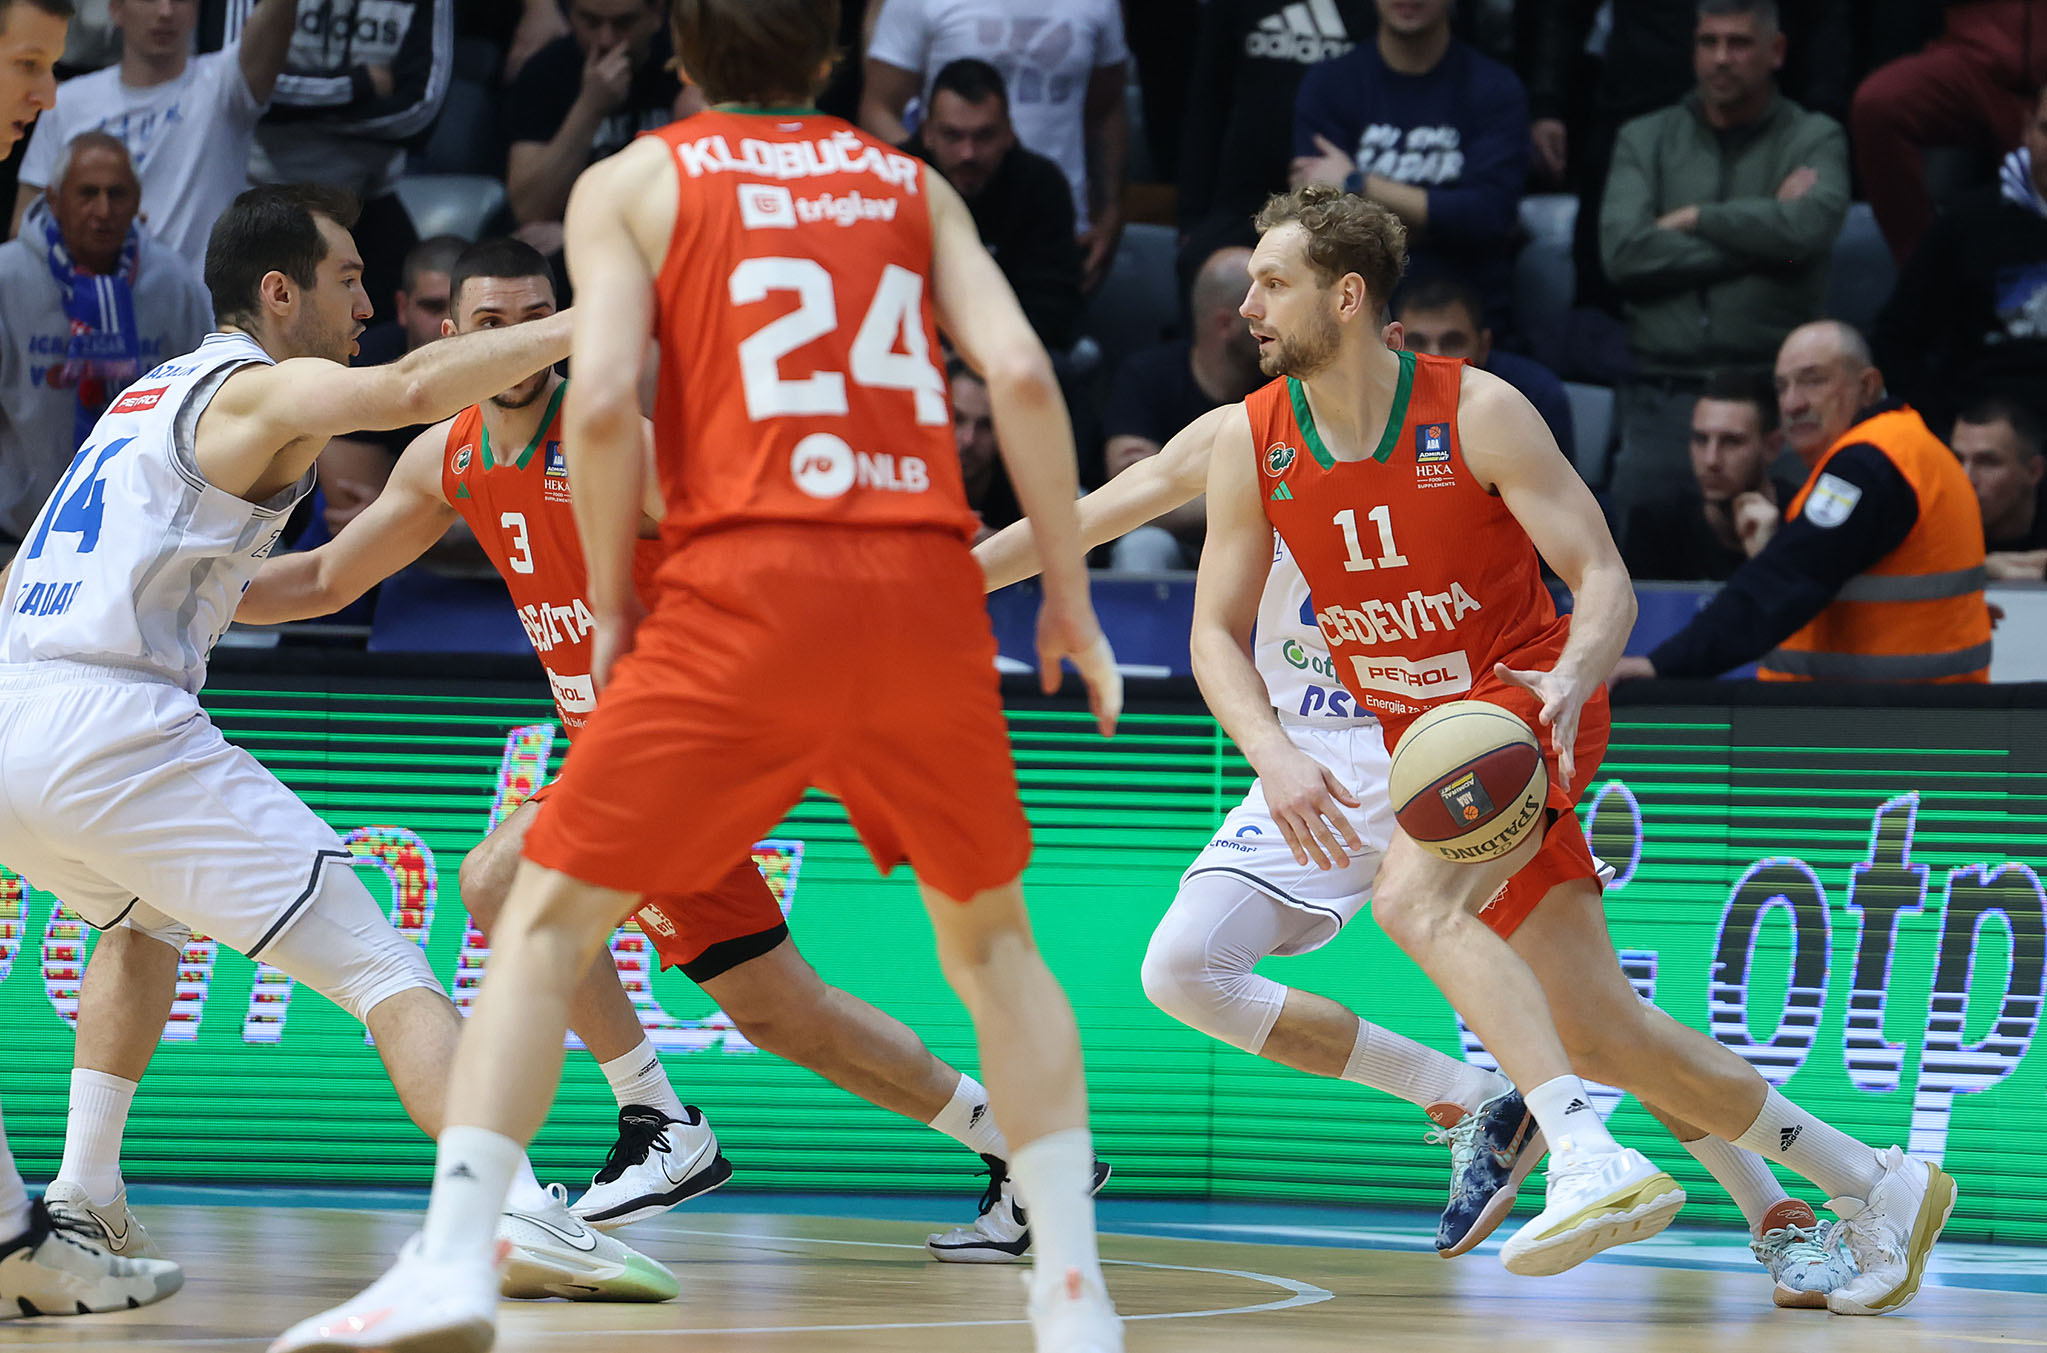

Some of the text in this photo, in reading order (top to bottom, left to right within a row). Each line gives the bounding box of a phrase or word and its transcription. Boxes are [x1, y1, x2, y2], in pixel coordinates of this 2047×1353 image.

[677, 130, 918, 195] KLOBUČAR
[795, 190, 899, 226] triglav
[728, 256, 949, 426] 24
[27, 435, 138, 560] 14
[856, 450, 931, 493] NLB
[1416, 465, 1453, 476] HEKA
[501, 512, 534, 574] 3
[1332, 504, 1409, 572] 11
[1315, 581, 1482, 647] CEDEVITA
[1365, 694, 1406, 714] Energija
[1367, 666, 1459, 687] PETROL
[1439, 794, 1540, 860] SPALDING
[1707, 789, 2047, 1170] otp
[1781, 1124, 1803, 1152] adidas
